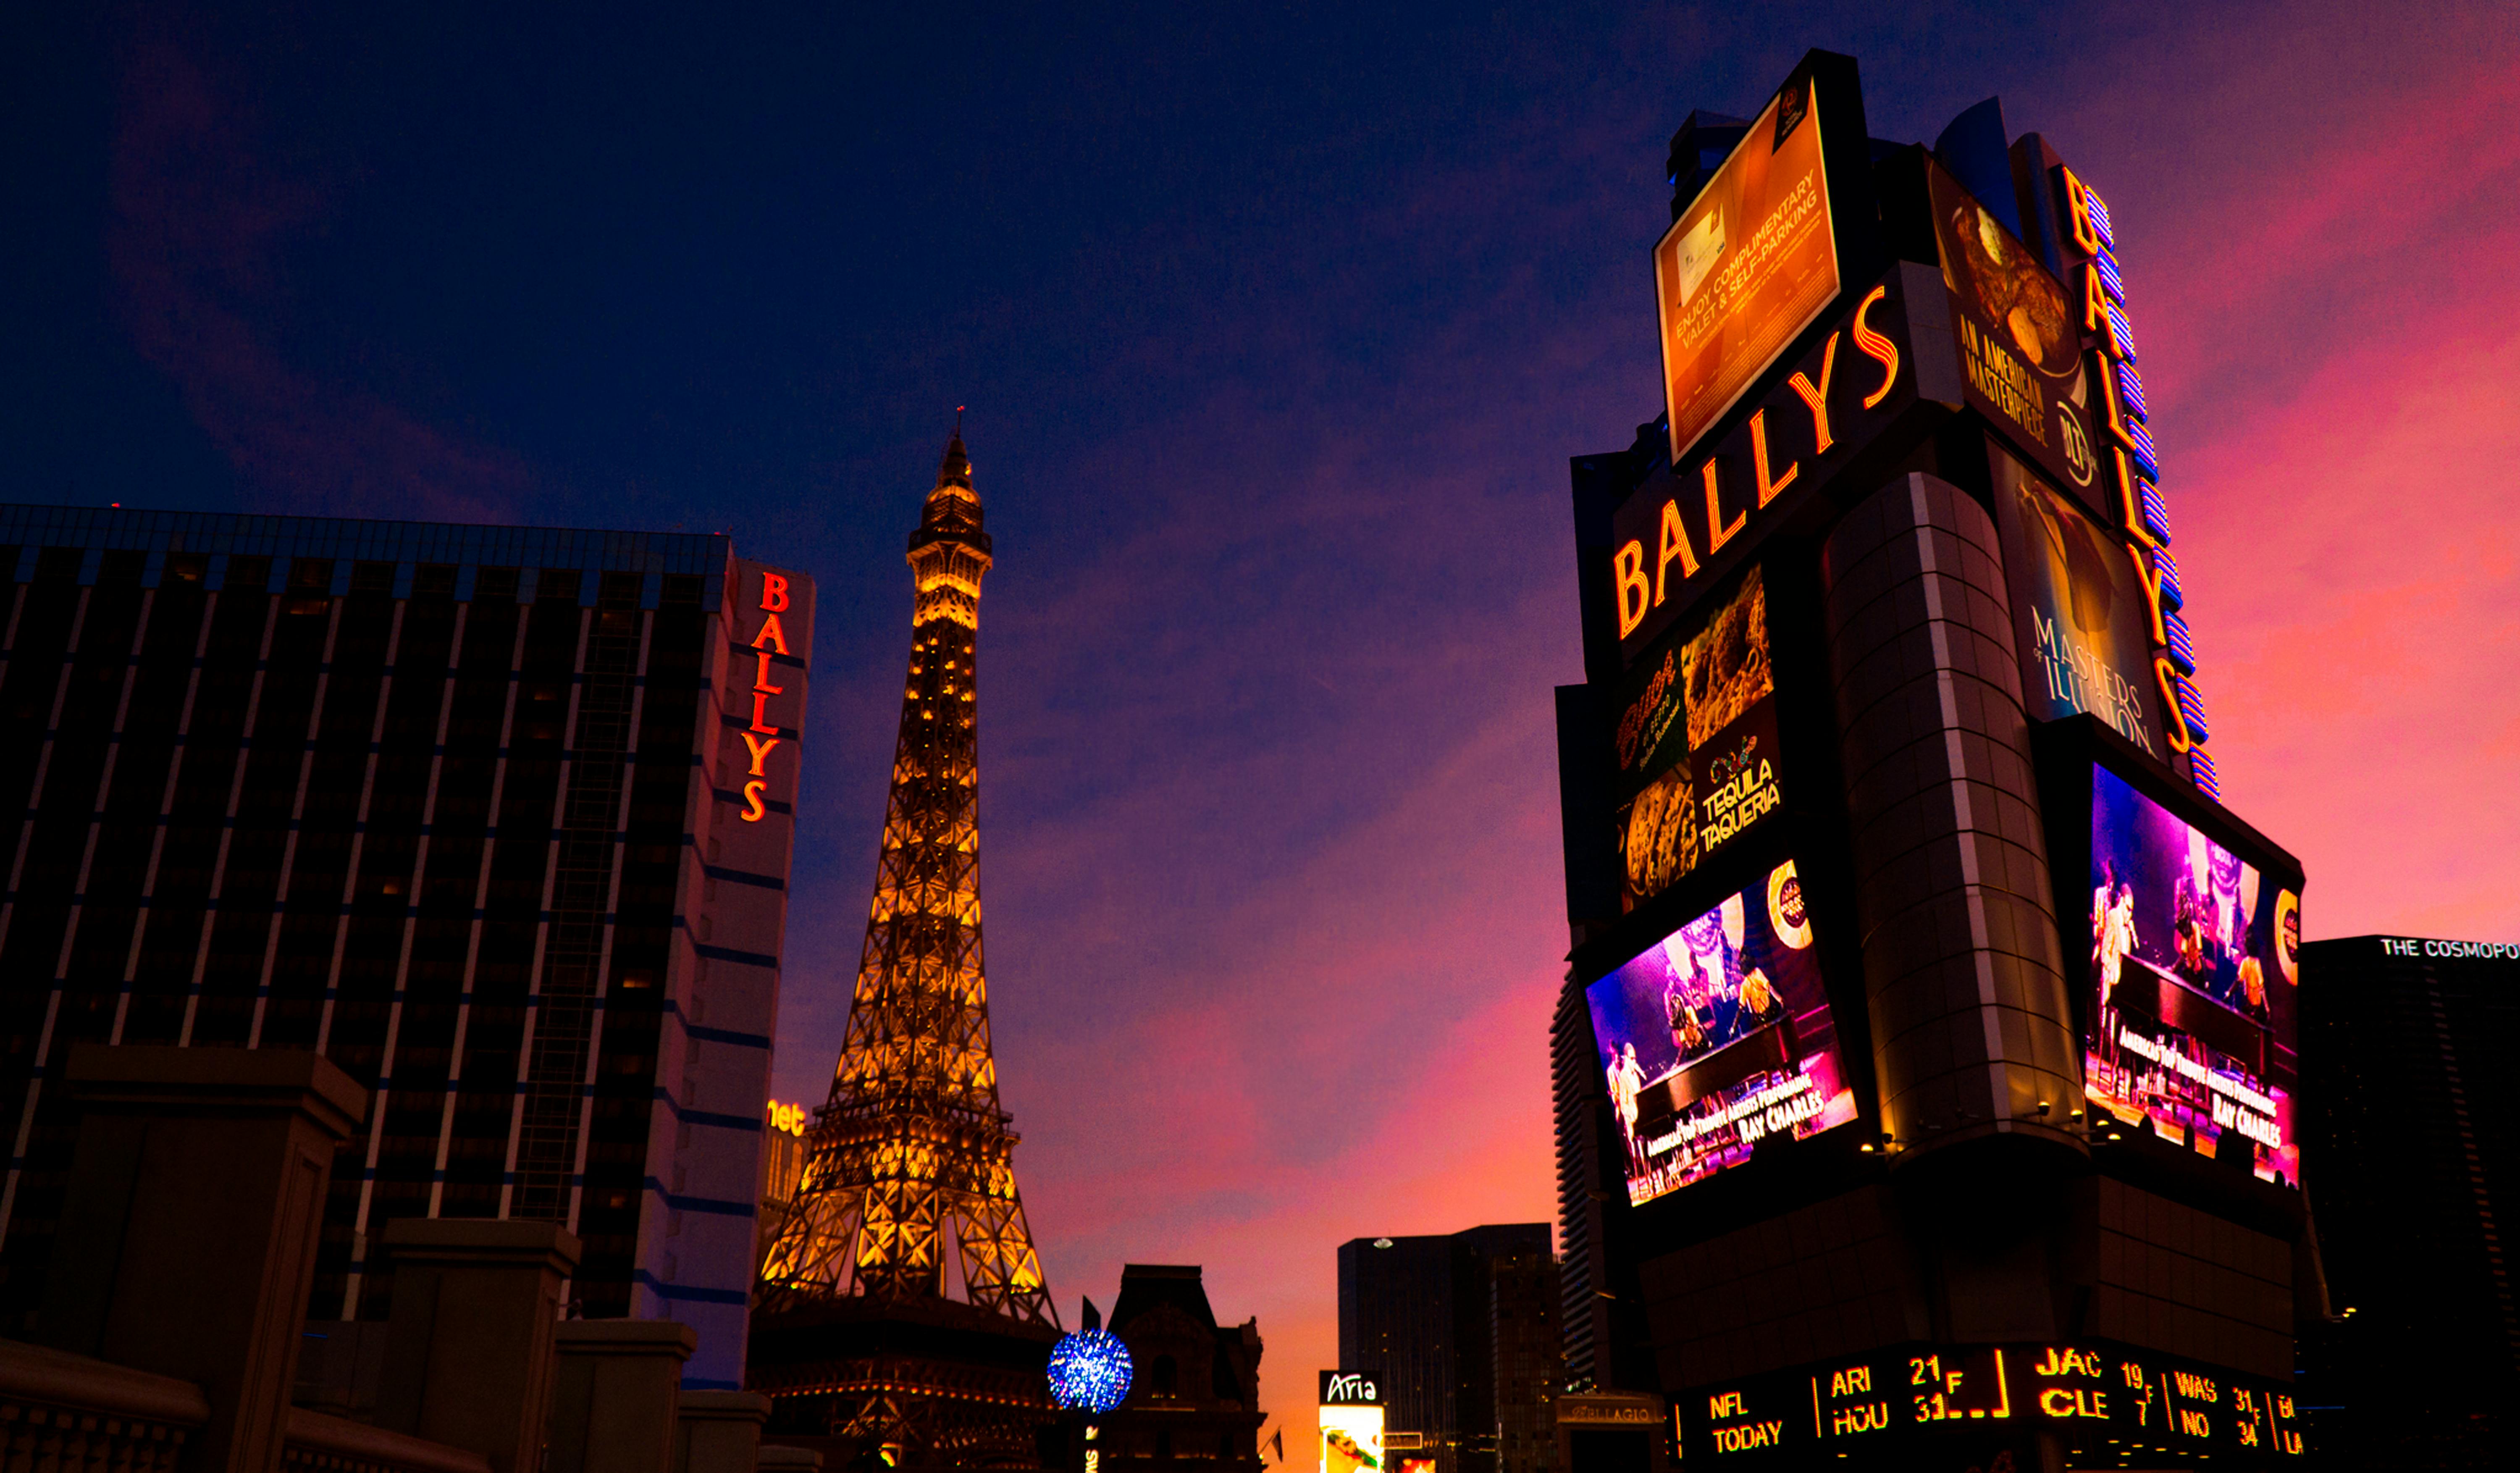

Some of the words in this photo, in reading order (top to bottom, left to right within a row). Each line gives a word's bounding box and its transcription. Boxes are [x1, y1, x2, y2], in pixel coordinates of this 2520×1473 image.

[1676, 288, 1711, 339] ENJOY
[1714, 168, 1814, 294] COMPLIMENTARY
[1683, 302, 1717, 349] VALET
[1719, 293, 1727, 310] &
[1729, 190, 1817, 297] SELF-PARKING
[1961, 314, 1979, 357] AN
[1984, 334, 2045, 414] AMERICAN
[1965, 349, 2048, 448] MASTERPIECE
[1614, 285, 1899, 640] BALLYS
[2059, 415, 2084, 470] BLT
[2062, 165, 2190, 753] BALLYS
[2031, 605, 2142, 719] MASTERS
[740, 571, 790, 822] BALLYS
[1700, 783, 1780, 852] TAQUERIA
[1702, 758, 1772, 822] TEQUILA
[2380, 939, 2420, 956] THE
[2425, 940, 2520, 960] COSMOPO
[1695, 1109, 1728, 1132] TRIBUTE
[1727, 1097, 1759, 1122] ARTISTS
[1757, 1073, 1814, 1109] PERFORMING
[2176, 1052, 2208, 1085] TRIBUTE
[2206, 1067, 2235, 1098] ARTISTS
[1738, 1114, 1766, 1145] RAY
[1766, 1090, 1825, 1133] CHARLES
[2213, 1093, 2237, 1130] RAY
[2236, 1105, 2281, 1150] CHARLES
[1327, 1373, 1377, 1402] Aria
[1831, 1365, 1872, 1398] ARI
[1909, 1354, 1940, 1385] 21
[1946, 1371, 1964, 1394] F
[2035, 1347, 2102, 1377] JAC
[2120, 1362, 2144, 1389] 19
[2145, 1384, 2153, 1404] F
[2174, 1371, 2218, 1403] WAS
[2232, 1387, 2253, 1413] 31
[2253, 1407, 2261, 1426] F
[1572, 1405, 1649, 1421] BELLAGIO
[1710, 1392, 1748, 1420] NFL
[1832, 1401, 1889, 1436] HOU
[1914, 1393, 1945, 1423] 31
[2040, 1389, 2110, 1420] CLE
[2135, 1400, 2146, 1426] 7
[2180, 1409, 2210, 1438] NO
[2236, 1420, 2258, 1447] 34
[1712, 1420, 1782, 1454] TODAY
